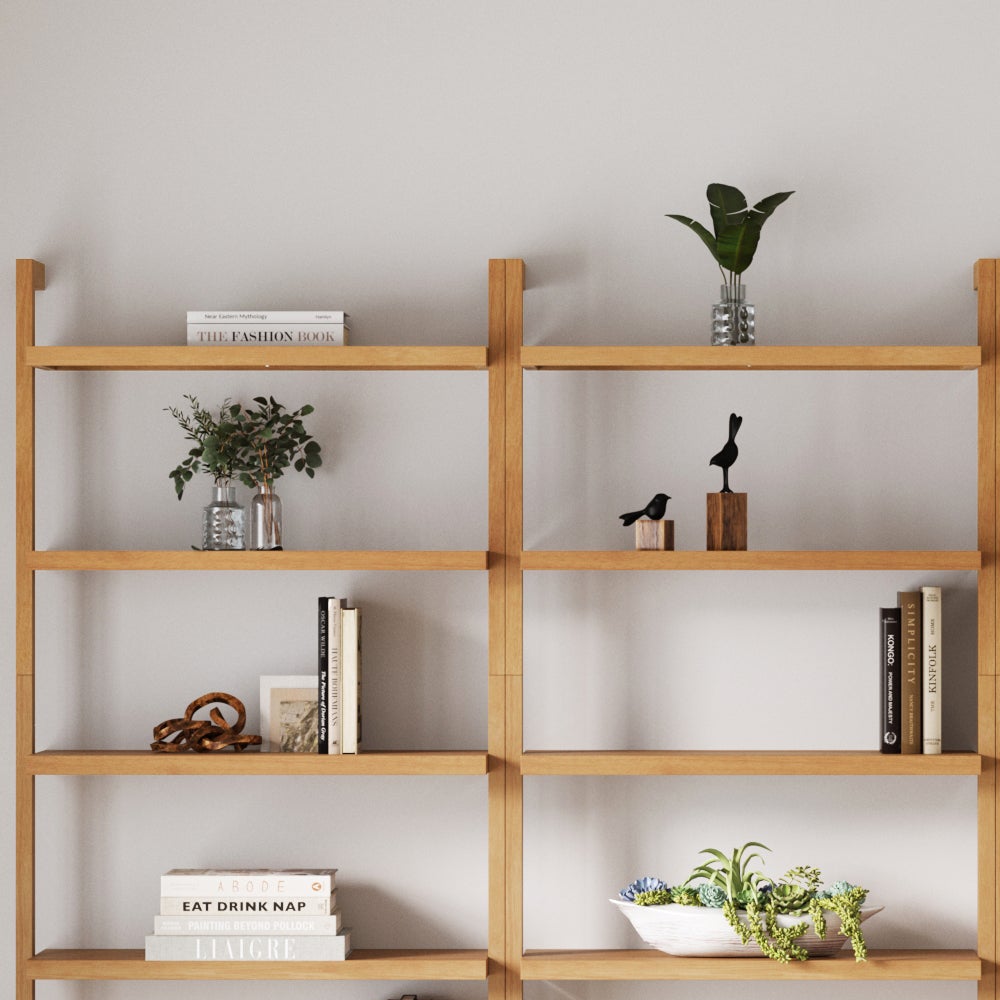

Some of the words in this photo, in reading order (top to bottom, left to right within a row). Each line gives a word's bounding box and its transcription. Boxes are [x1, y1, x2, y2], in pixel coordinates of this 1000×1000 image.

[197, 331, 228, 342] THE
[232, 331, 293, 342] FASHION
[298, 331, 334, 342] BOOK
[887, 634, 895, 666] KONGO:
[907, 603, 916, 684] SIMPLICITY
[928, 644, 937, 693] KINFOLK
[217, 880, 285, 893] ABODE
[182, 901, 212, 912] EAT
[217, 901, 268, 912] DRINK
[273, 901, 306, 912] NAP
[188, 920, 231, 931] PAINTING
[233, 920, 271, 931] BEYOND
[273, 920, 315, 931] POLLOCK
[195, 938, 296, 960] LIAIGRE
